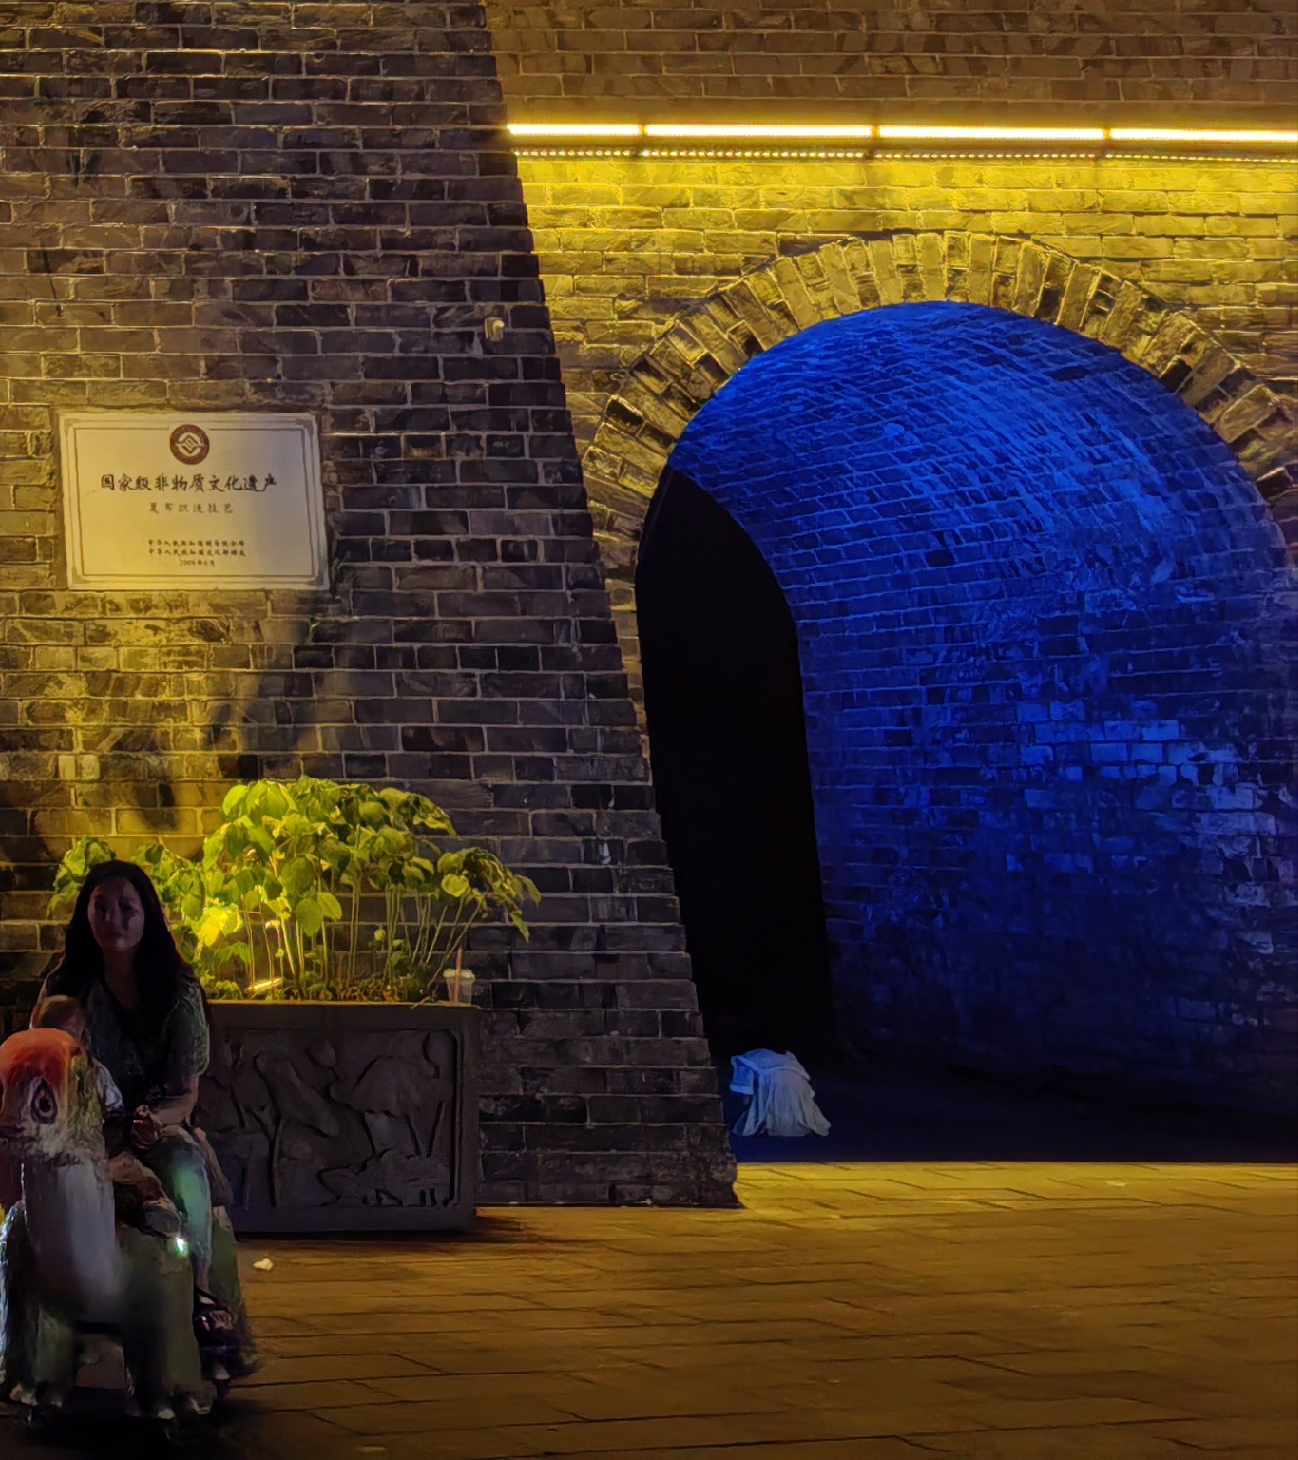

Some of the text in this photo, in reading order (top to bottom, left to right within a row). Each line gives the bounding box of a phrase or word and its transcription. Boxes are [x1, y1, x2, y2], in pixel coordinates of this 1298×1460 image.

[101, 472, 278, 493] 国家级非物质文化遗产
